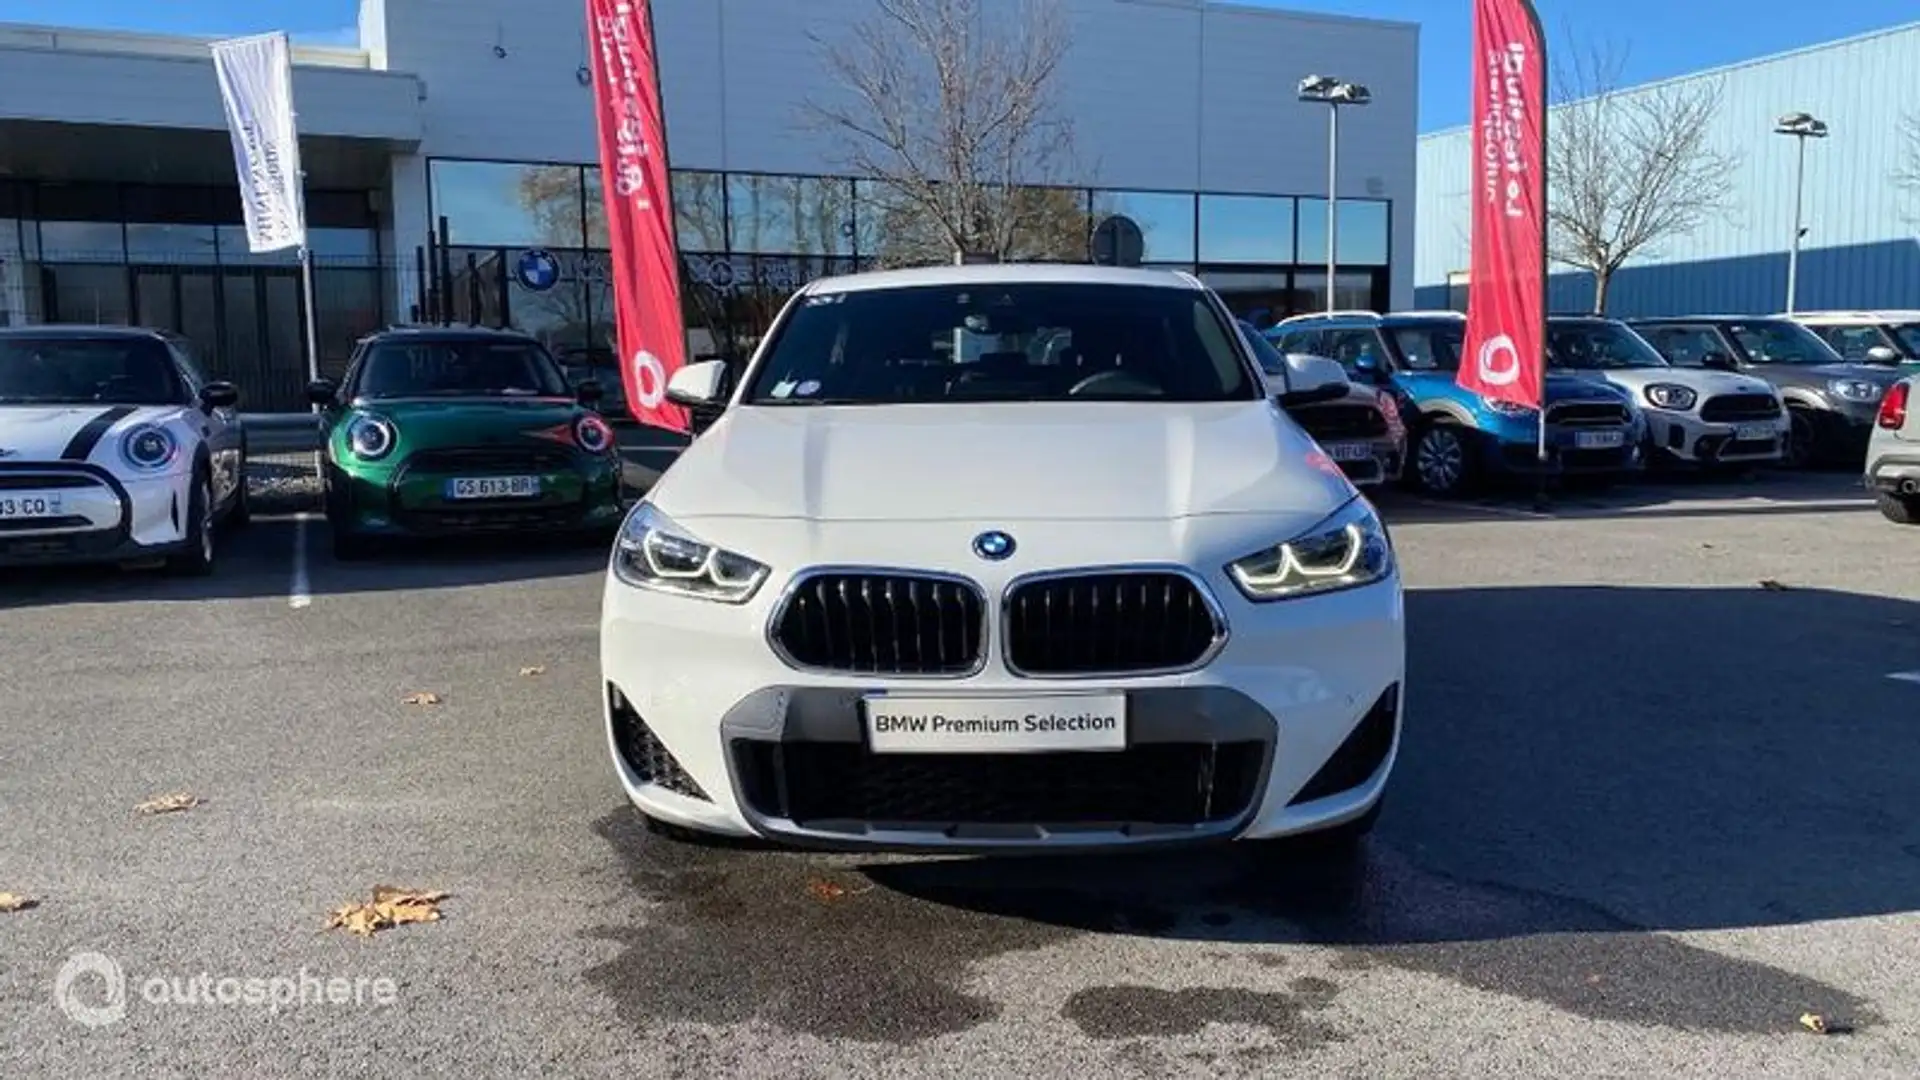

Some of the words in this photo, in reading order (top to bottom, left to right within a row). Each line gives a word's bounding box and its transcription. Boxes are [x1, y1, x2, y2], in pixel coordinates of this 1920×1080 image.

[875, 715, 927, 732] BMW
[932, 714, 1019, 732] Premium
[1024, 713, 1116, 731] Selection
